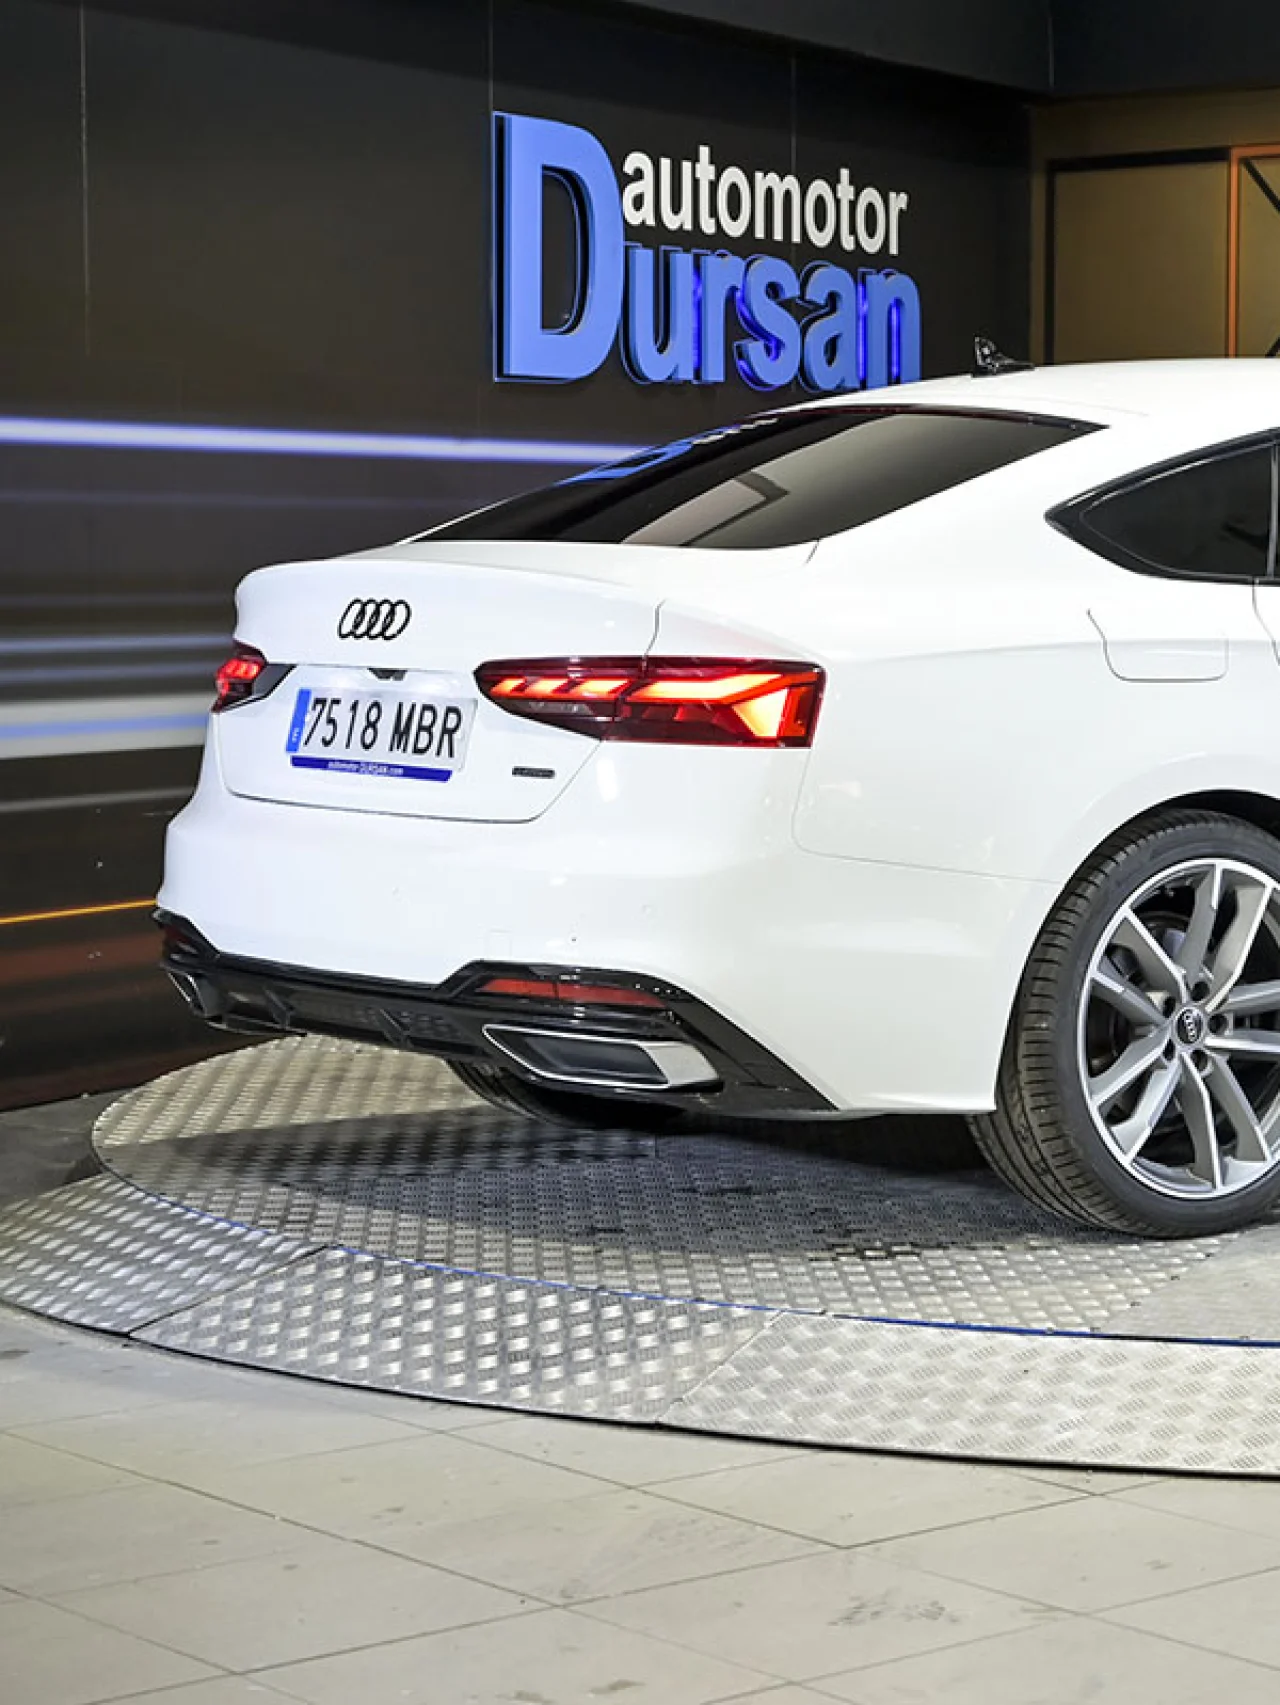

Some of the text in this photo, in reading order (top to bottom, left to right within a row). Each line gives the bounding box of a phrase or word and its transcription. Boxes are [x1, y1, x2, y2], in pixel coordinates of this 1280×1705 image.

[493, 110, 922, 392] Dursan
[622, 144, 908, 256] automotor
[303, 697, 384, 751] 7518
[388, 701, 463, 759] MBR
